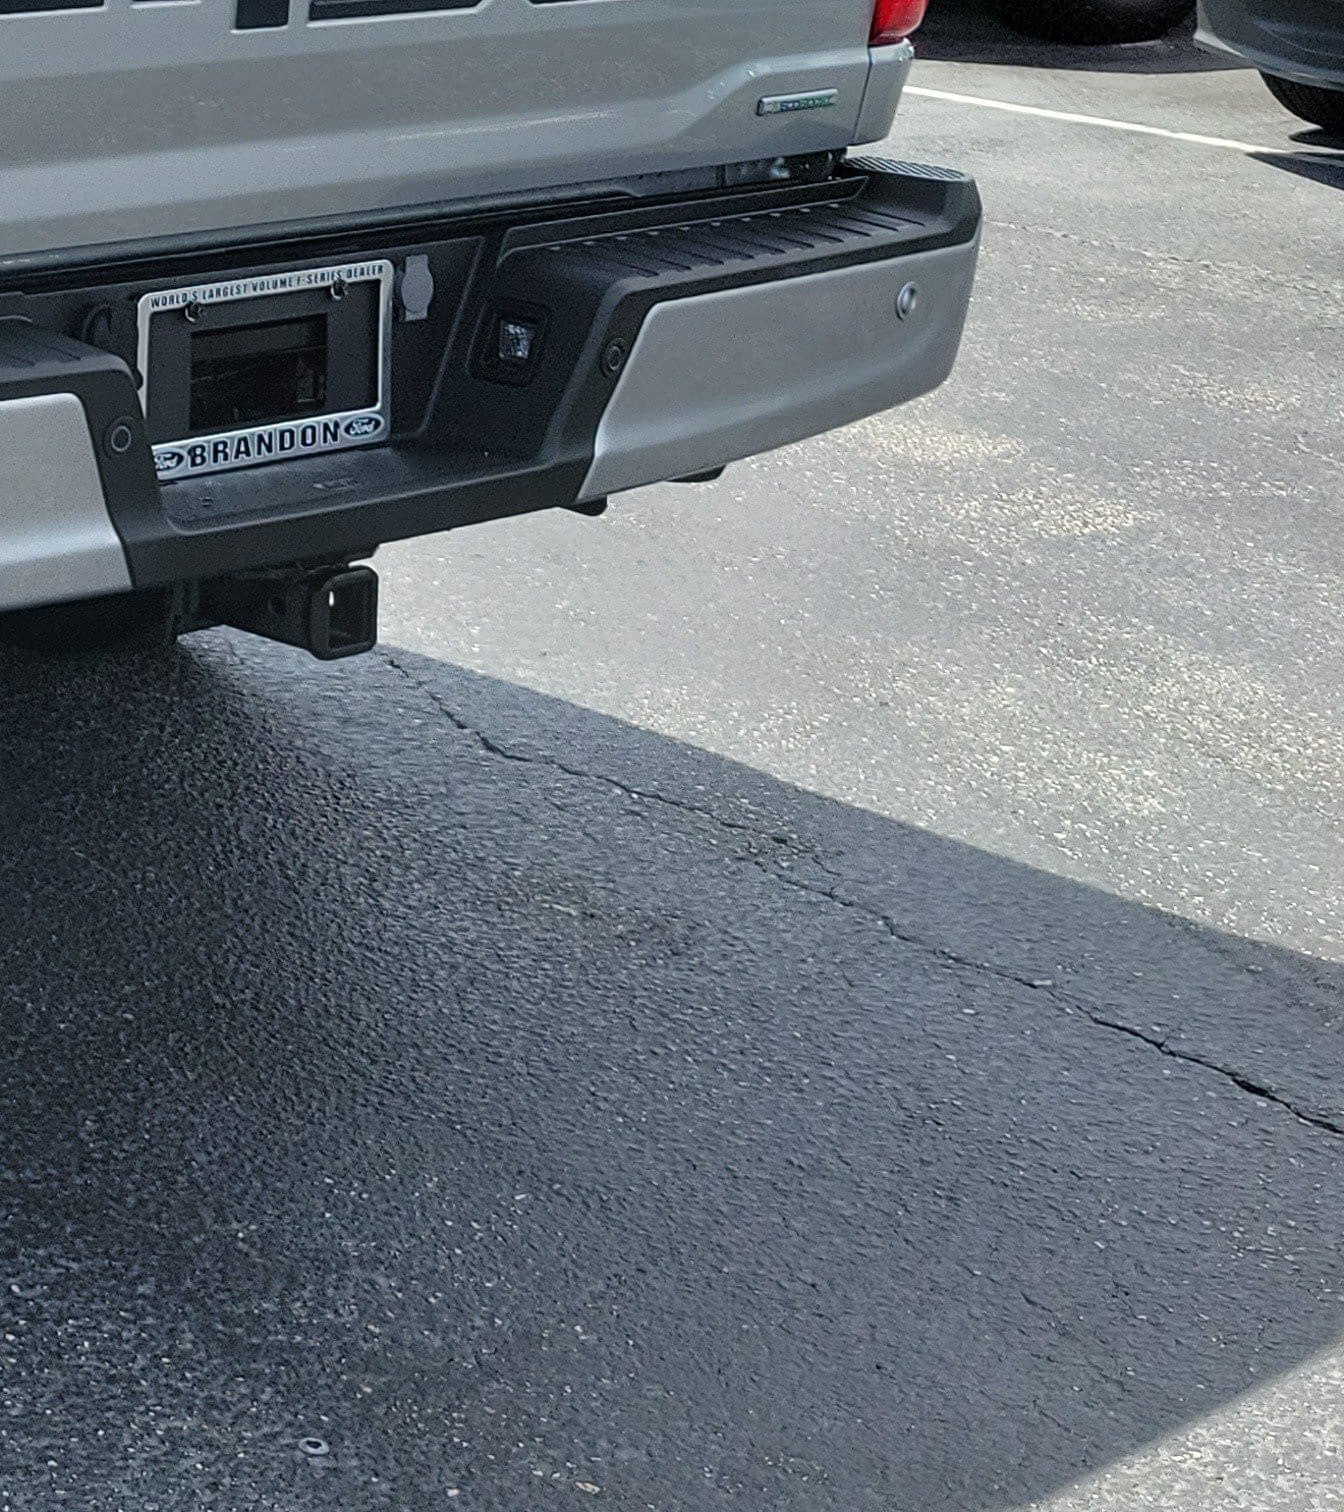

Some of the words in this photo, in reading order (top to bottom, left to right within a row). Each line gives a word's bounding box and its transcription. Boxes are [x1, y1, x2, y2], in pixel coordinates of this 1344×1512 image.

[202, 284, 247, 301] LARGEST
[251, 276, 292, 292] VOLUME
[346, 264, 384, 279] DEALER
[188, 419, 340, 468] BRANDON
